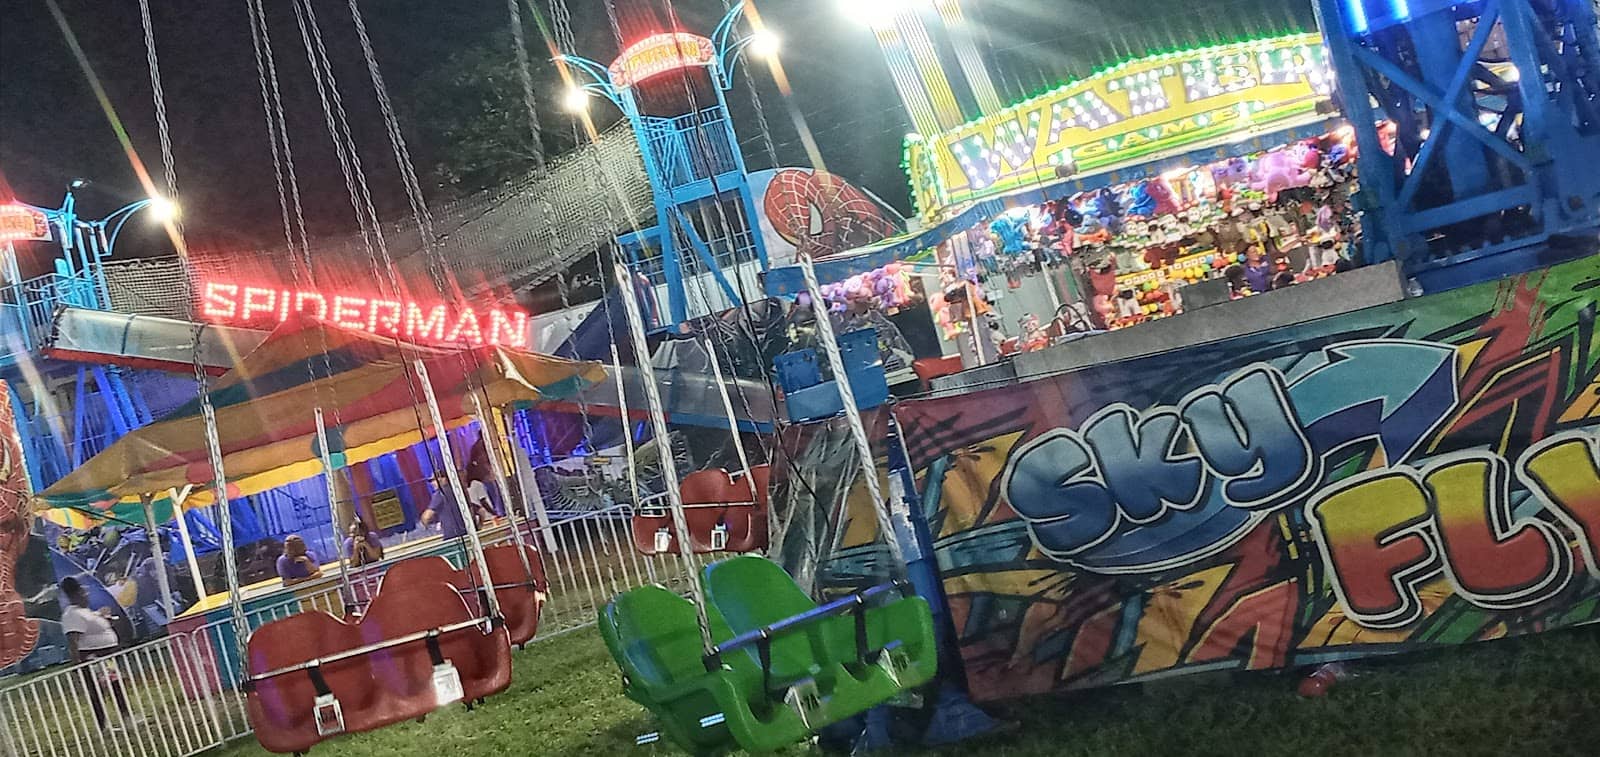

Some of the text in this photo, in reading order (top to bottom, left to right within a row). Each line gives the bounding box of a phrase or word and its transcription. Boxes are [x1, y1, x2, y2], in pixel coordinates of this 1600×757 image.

[948, 43, 1335, 190] WATER
[1071, 108, 1240, 157] GAME
[204, 282, 527, 347] SPIDERMAN
